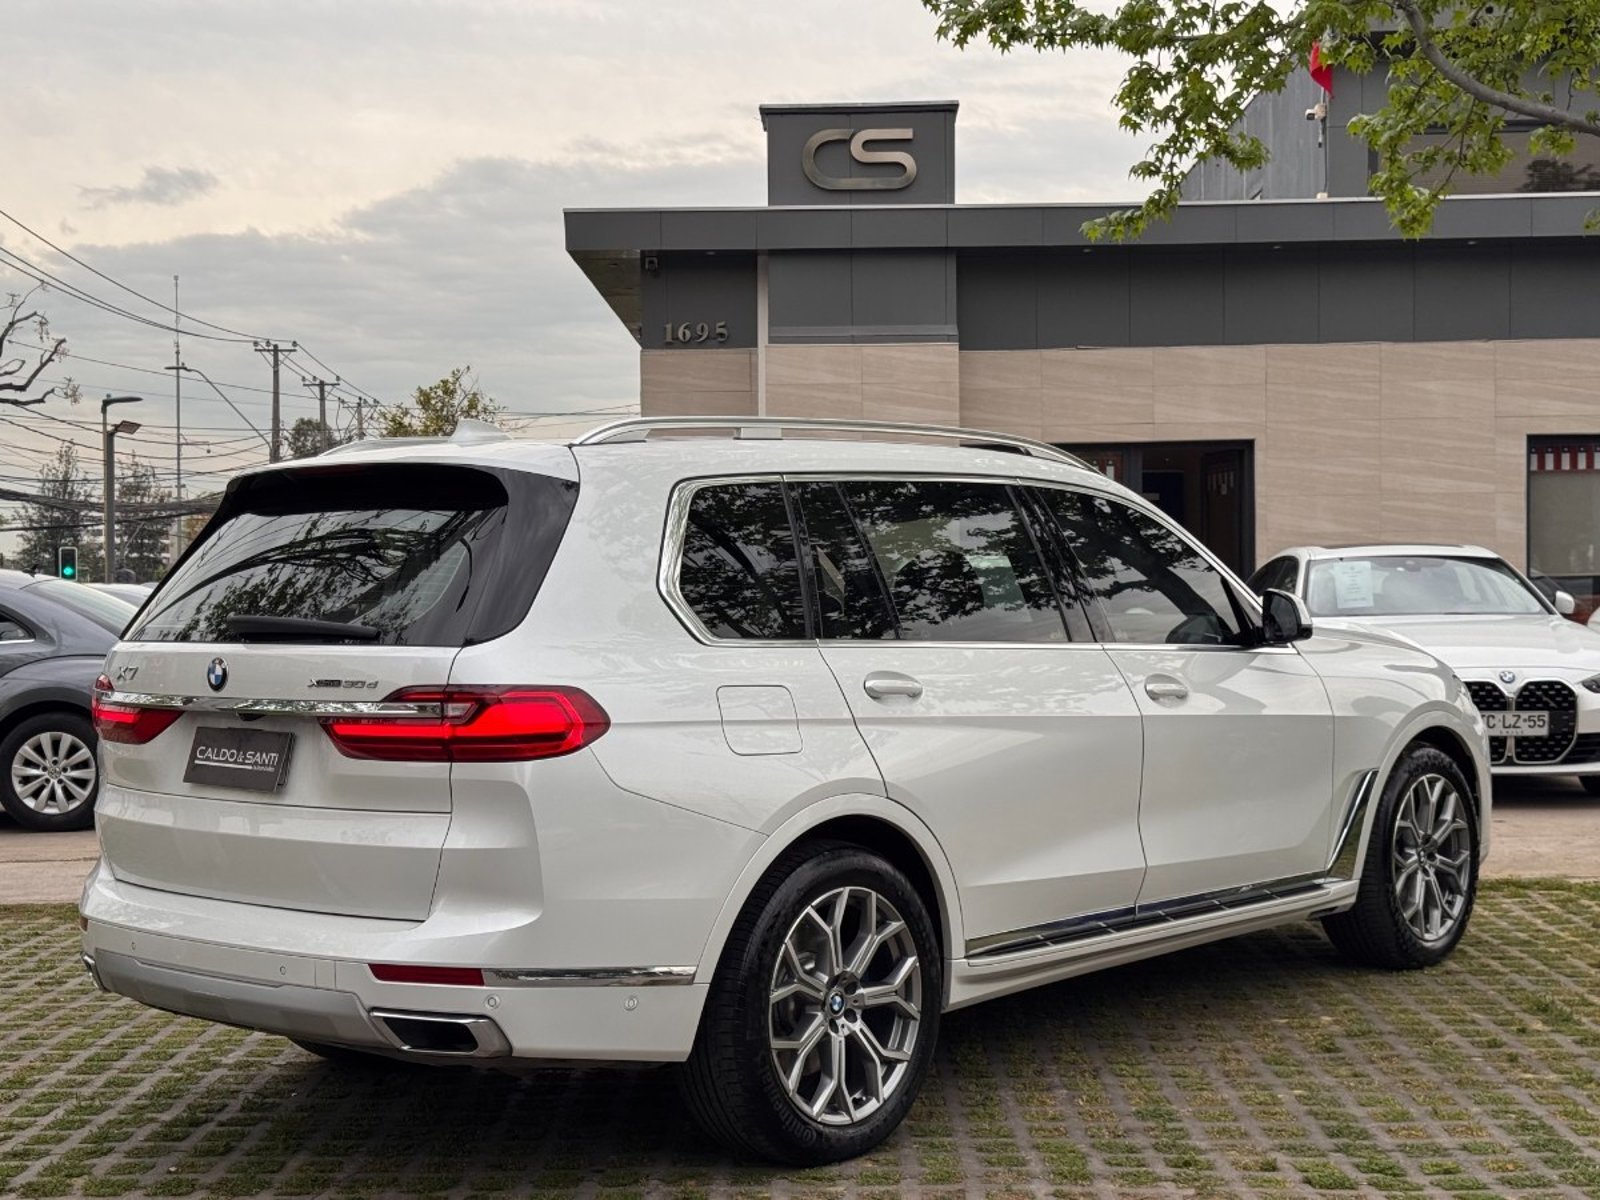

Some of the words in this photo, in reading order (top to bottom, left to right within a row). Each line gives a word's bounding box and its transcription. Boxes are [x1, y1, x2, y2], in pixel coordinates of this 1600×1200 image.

[664, 321, 728, 343] 1695
[117, 666, 139, 681] X7
[196, 746, 237, 762] CALDO
